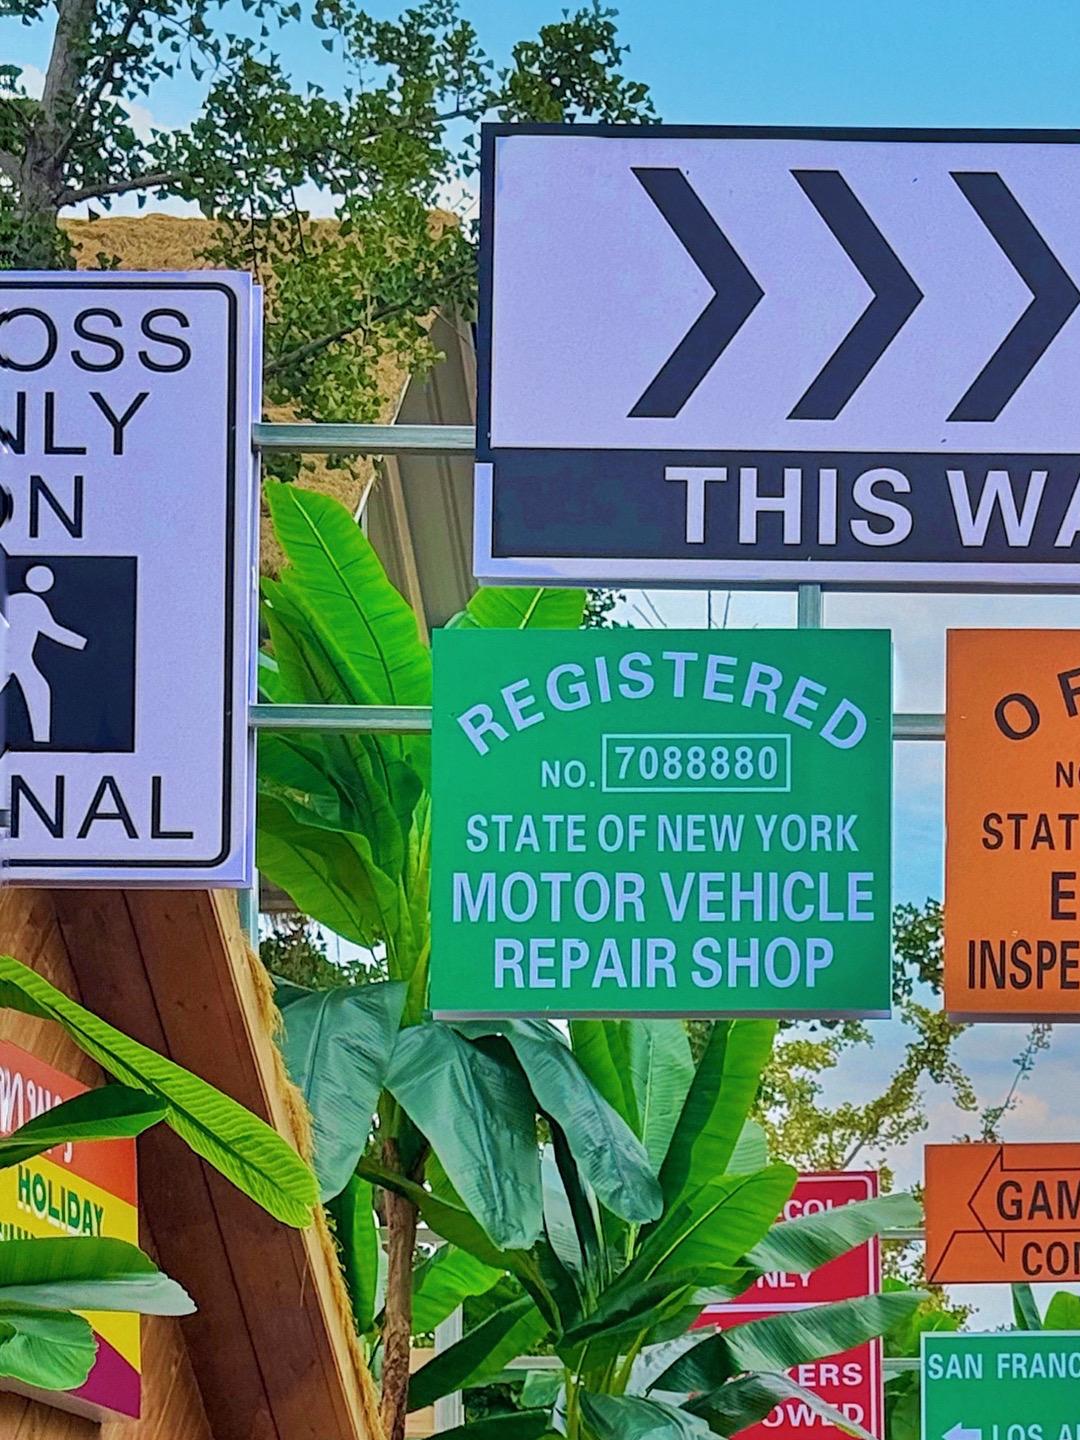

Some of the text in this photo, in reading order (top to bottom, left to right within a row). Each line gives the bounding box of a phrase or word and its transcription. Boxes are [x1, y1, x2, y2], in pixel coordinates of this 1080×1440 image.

[0, 475, 84, 538] N
[664, 466, 913, 548] THIS
[456, 651, 869, 756] REGISTERED
[540, 746, 779, 789] NO. 7088880
[10, 774, 194, 839] NAL
[466, 813, 859, 853] STATE OF NEW YORK
[451, 871, 876, 924] MOTOR VEHICLE
[494, 937, 835, 990] REPAIR SHOP
[18, 1164, 104, 1237] HOLIDAY
[928, 1352, 983, 1380] SAN
